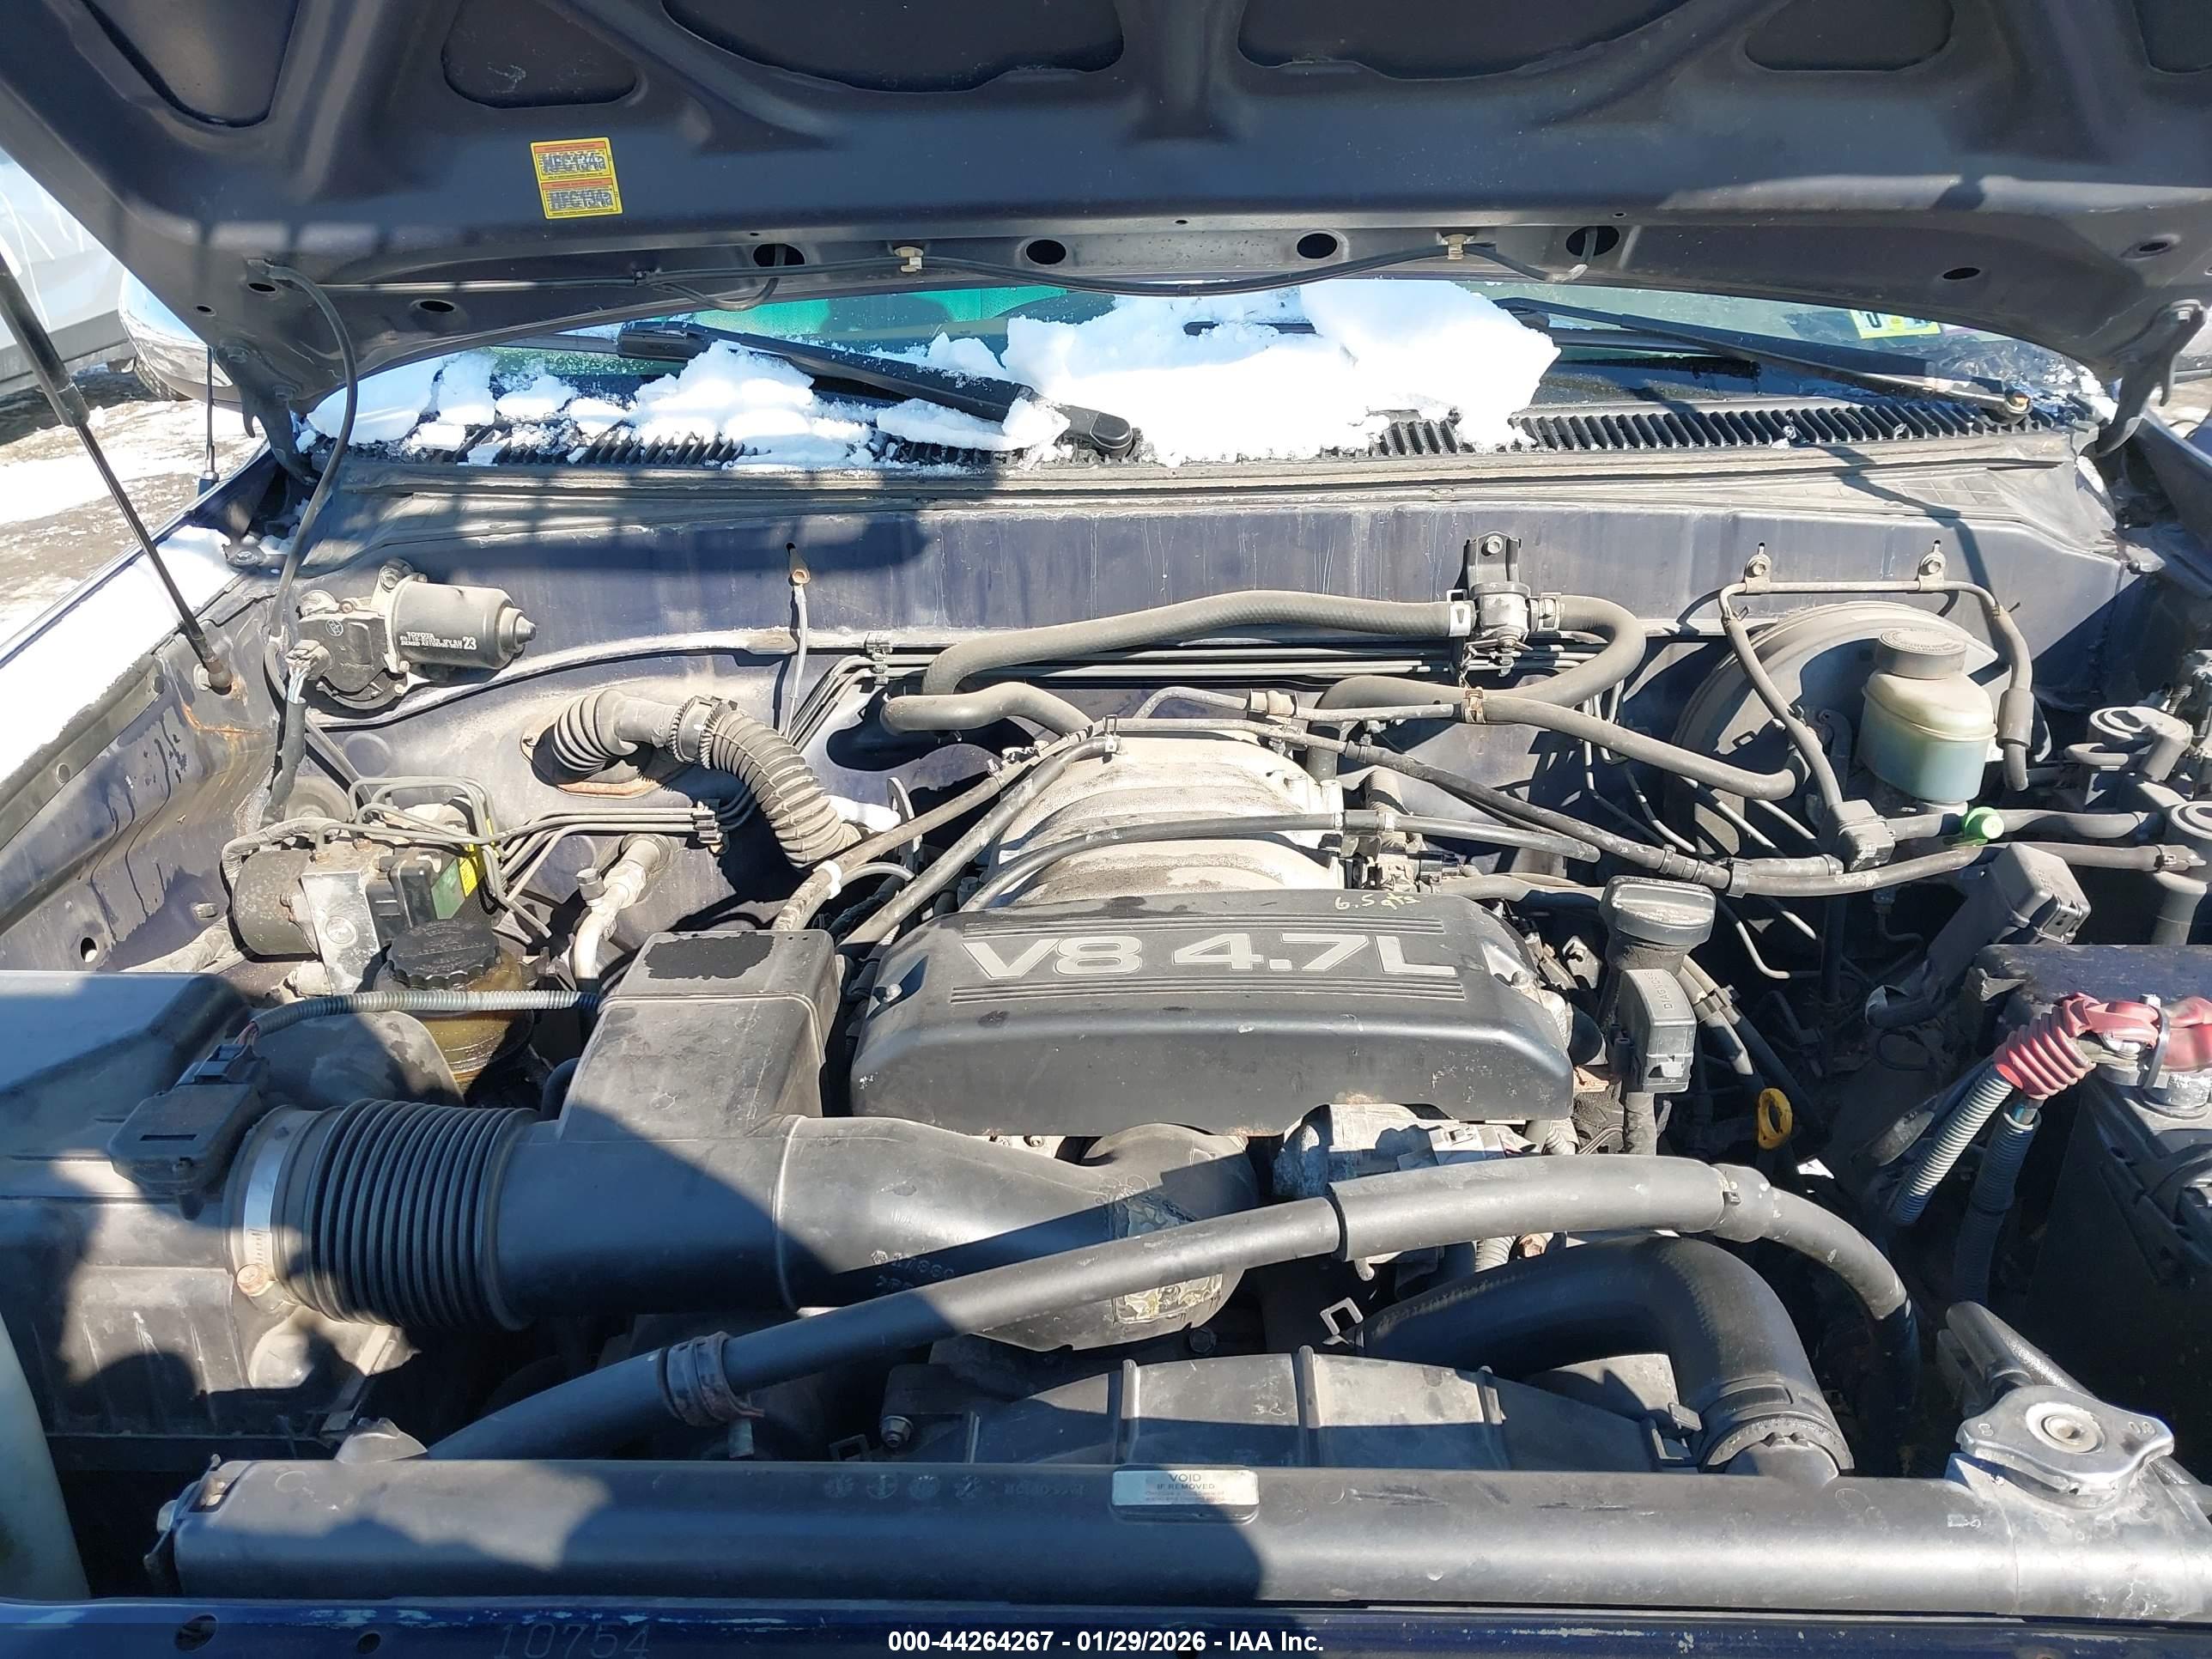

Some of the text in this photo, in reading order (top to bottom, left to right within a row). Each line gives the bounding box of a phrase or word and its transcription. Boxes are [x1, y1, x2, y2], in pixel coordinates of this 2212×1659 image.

[462, 635, 477, 650] 23
[962, 933, 1457, 979] V8 4.7L
[1169, 1473, 1202, 1483] VOID
